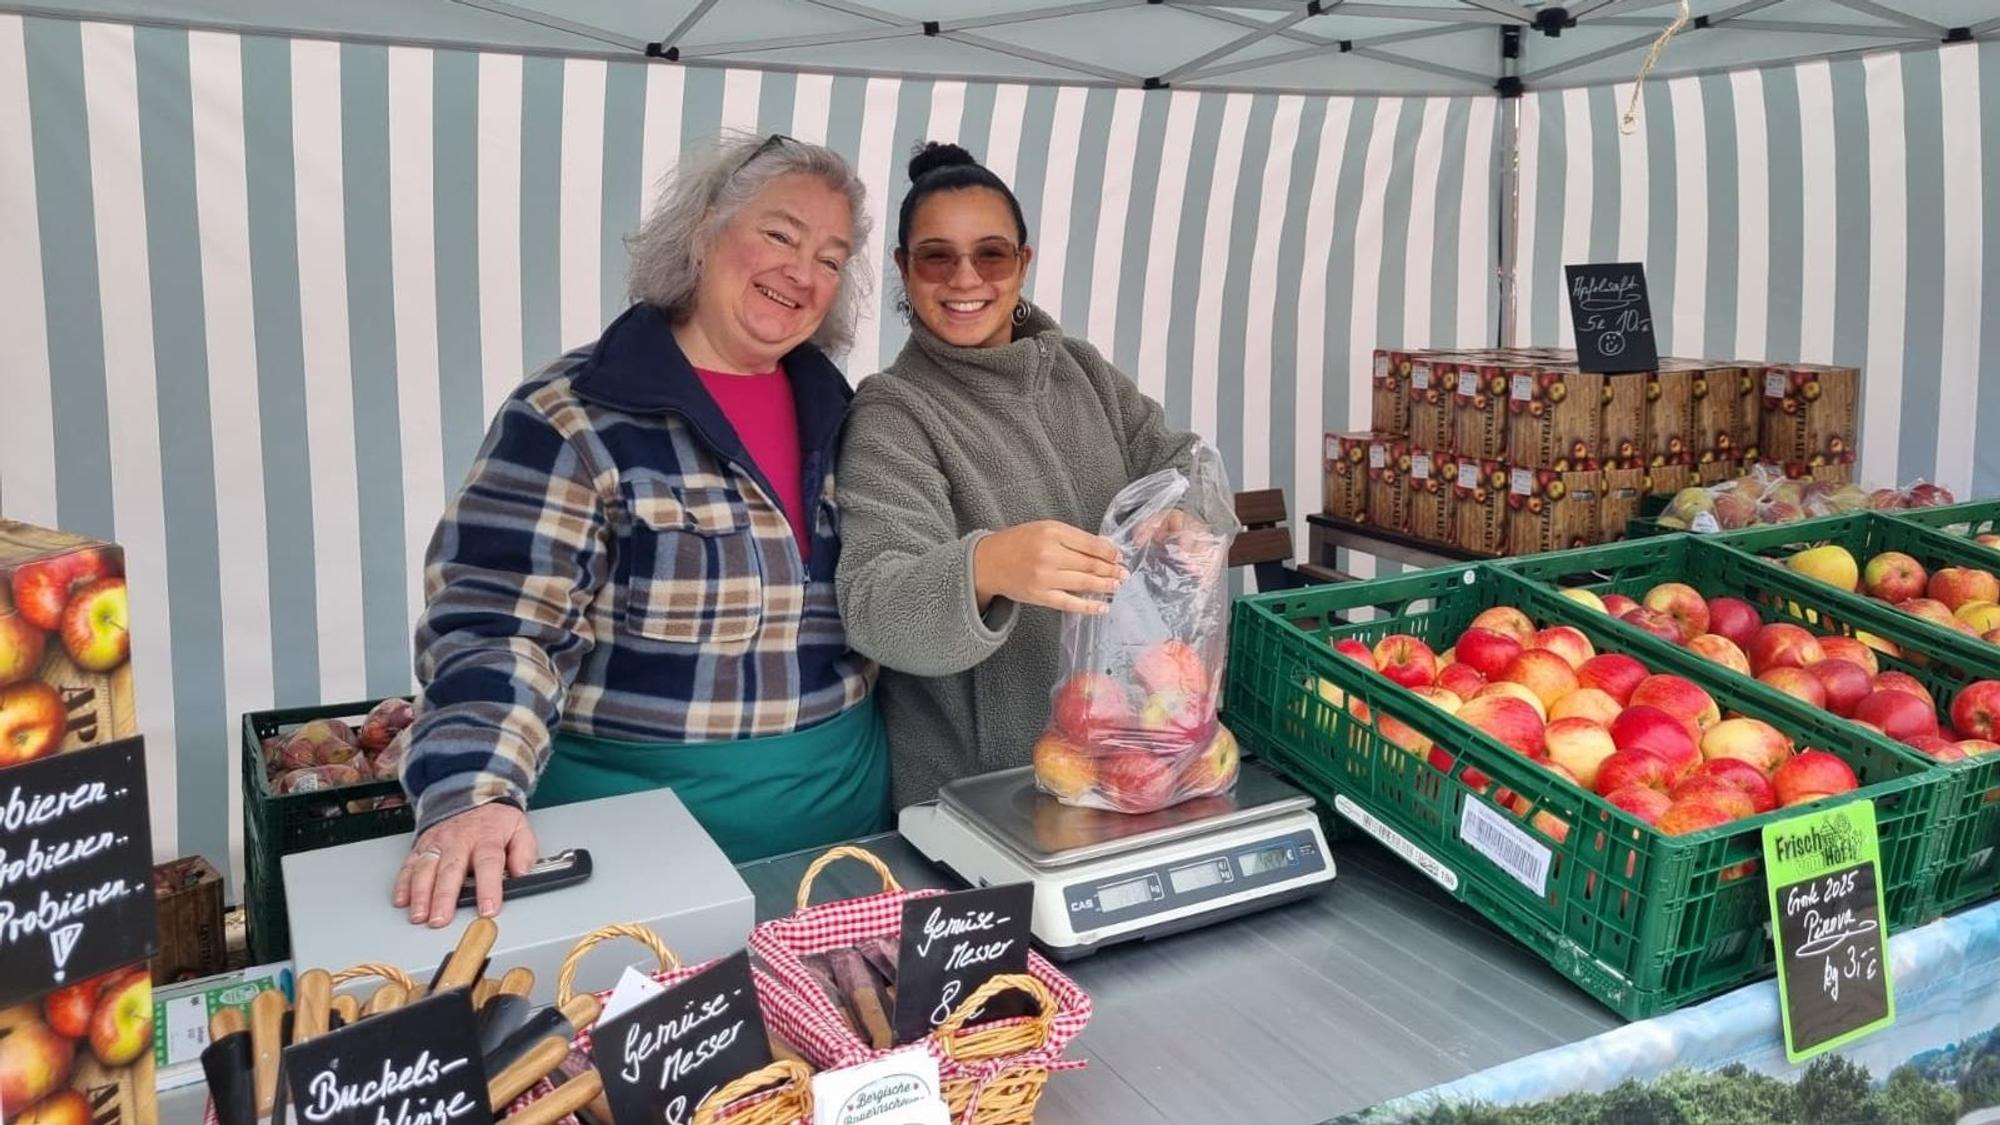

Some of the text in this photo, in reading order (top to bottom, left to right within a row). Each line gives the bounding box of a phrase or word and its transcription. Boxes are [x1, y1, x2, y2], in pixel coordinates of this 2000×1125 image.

[1775, 827, 1823, 862] Frisch
[1823, 870, 1859, 903] 2025
[1071, 899, 1094, 912] CAS
[944, 939, 1014, 971] Messer
[1824, 955, 1839, 1001] kg
[660, 1020, 744, 1090] Messer
[856, 1082, 911, 1109] Bergische
